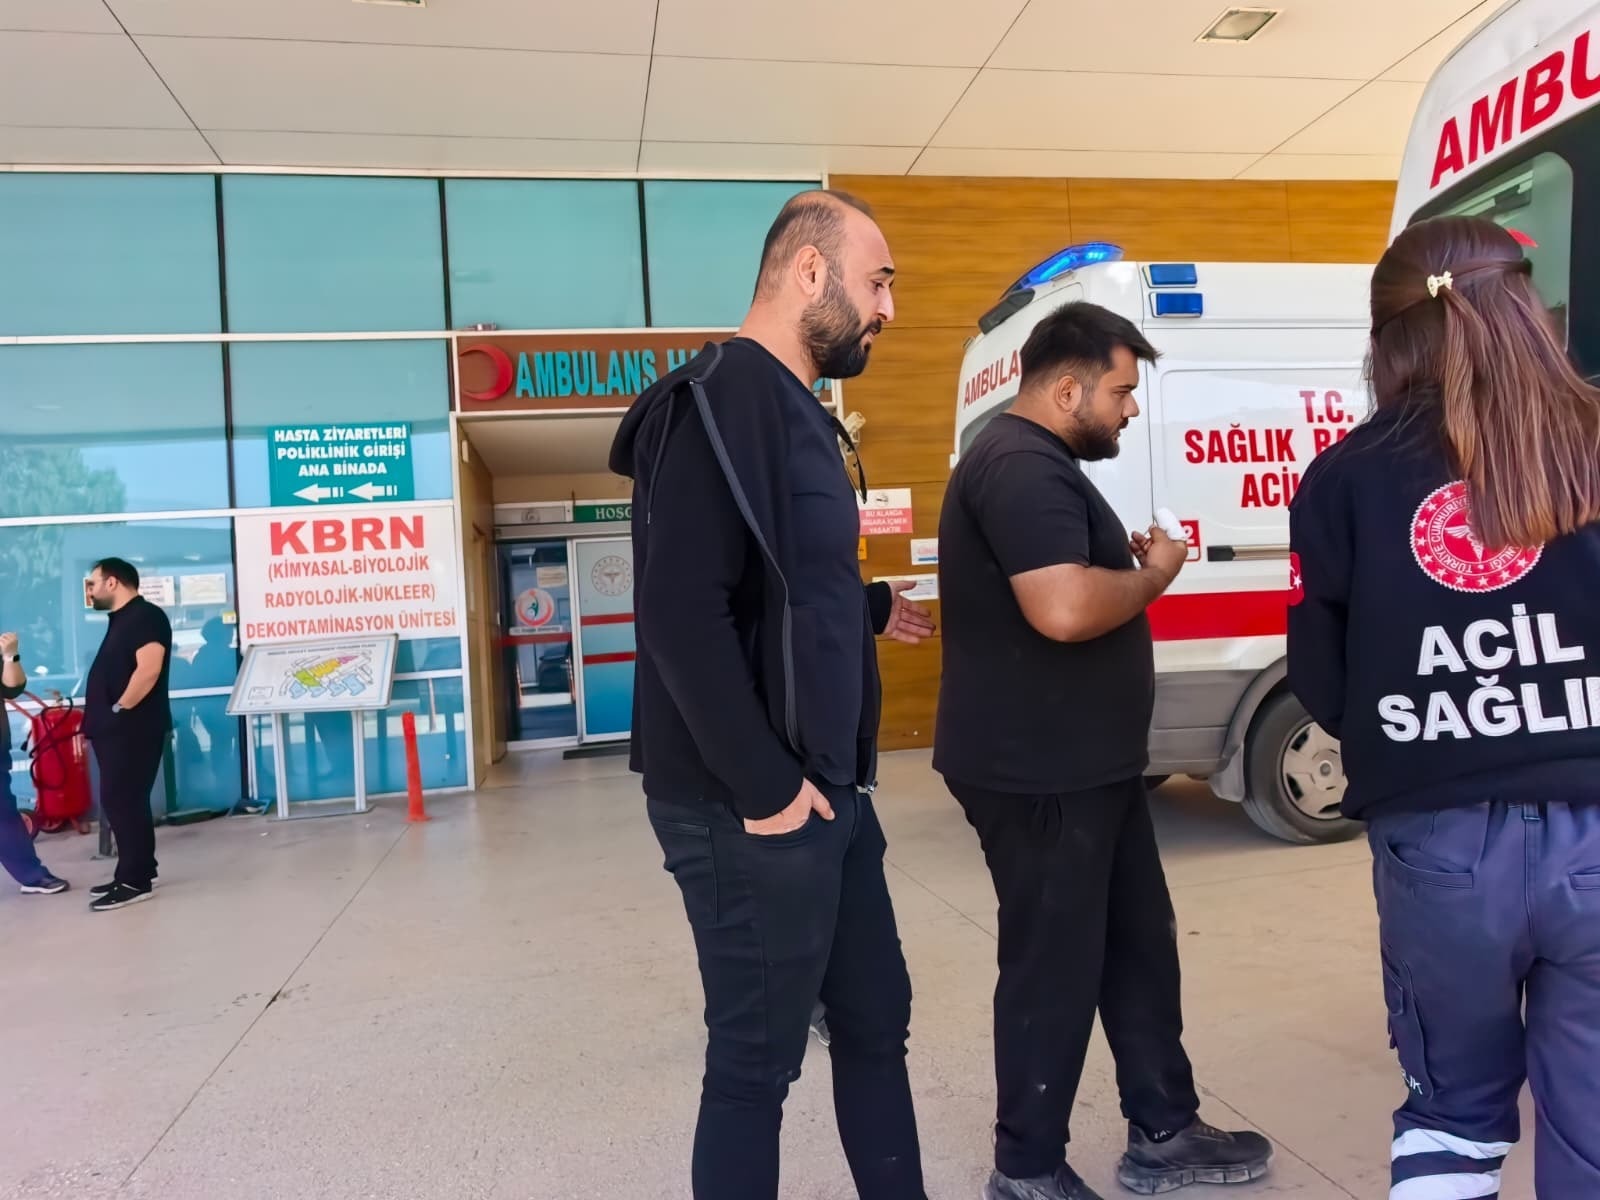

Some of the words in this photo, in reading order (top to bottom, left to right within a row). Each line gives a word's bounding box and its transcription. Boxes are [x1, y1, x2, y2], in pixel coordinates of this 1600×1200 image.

[515, 349, 658, 398] AMBULANS
[963, 350, 1019, 408] AMBULA
[1300, 390, 1354, 423] T.C.
[274, 428, 320, 442] HASTA
[323, 424, 407, 440] ZİYARETLERİ
[1184, 422, 1296, 464] SAĞLIK
[277, 443, 359, 460] POLİKLİNİK
[363, 441, 406, 459] GİRİŞİ
[298, 464, 330, 477] ANA
[333, 460, 387, 476] BİNADA
[270, 515, 424, 555] KBRN
[268, 552, 429, 583] (KİMYASAL-BİYOLOJİK
[265, 583, 436, 609] RADYOLOJİK-NÜKLEER)
[246, 613, 394, 640] DEKONTAMİNASYON
[399, 607, 456, 628] ÜNİTESİ
[1417, 602, 1585, 676] ACİL
